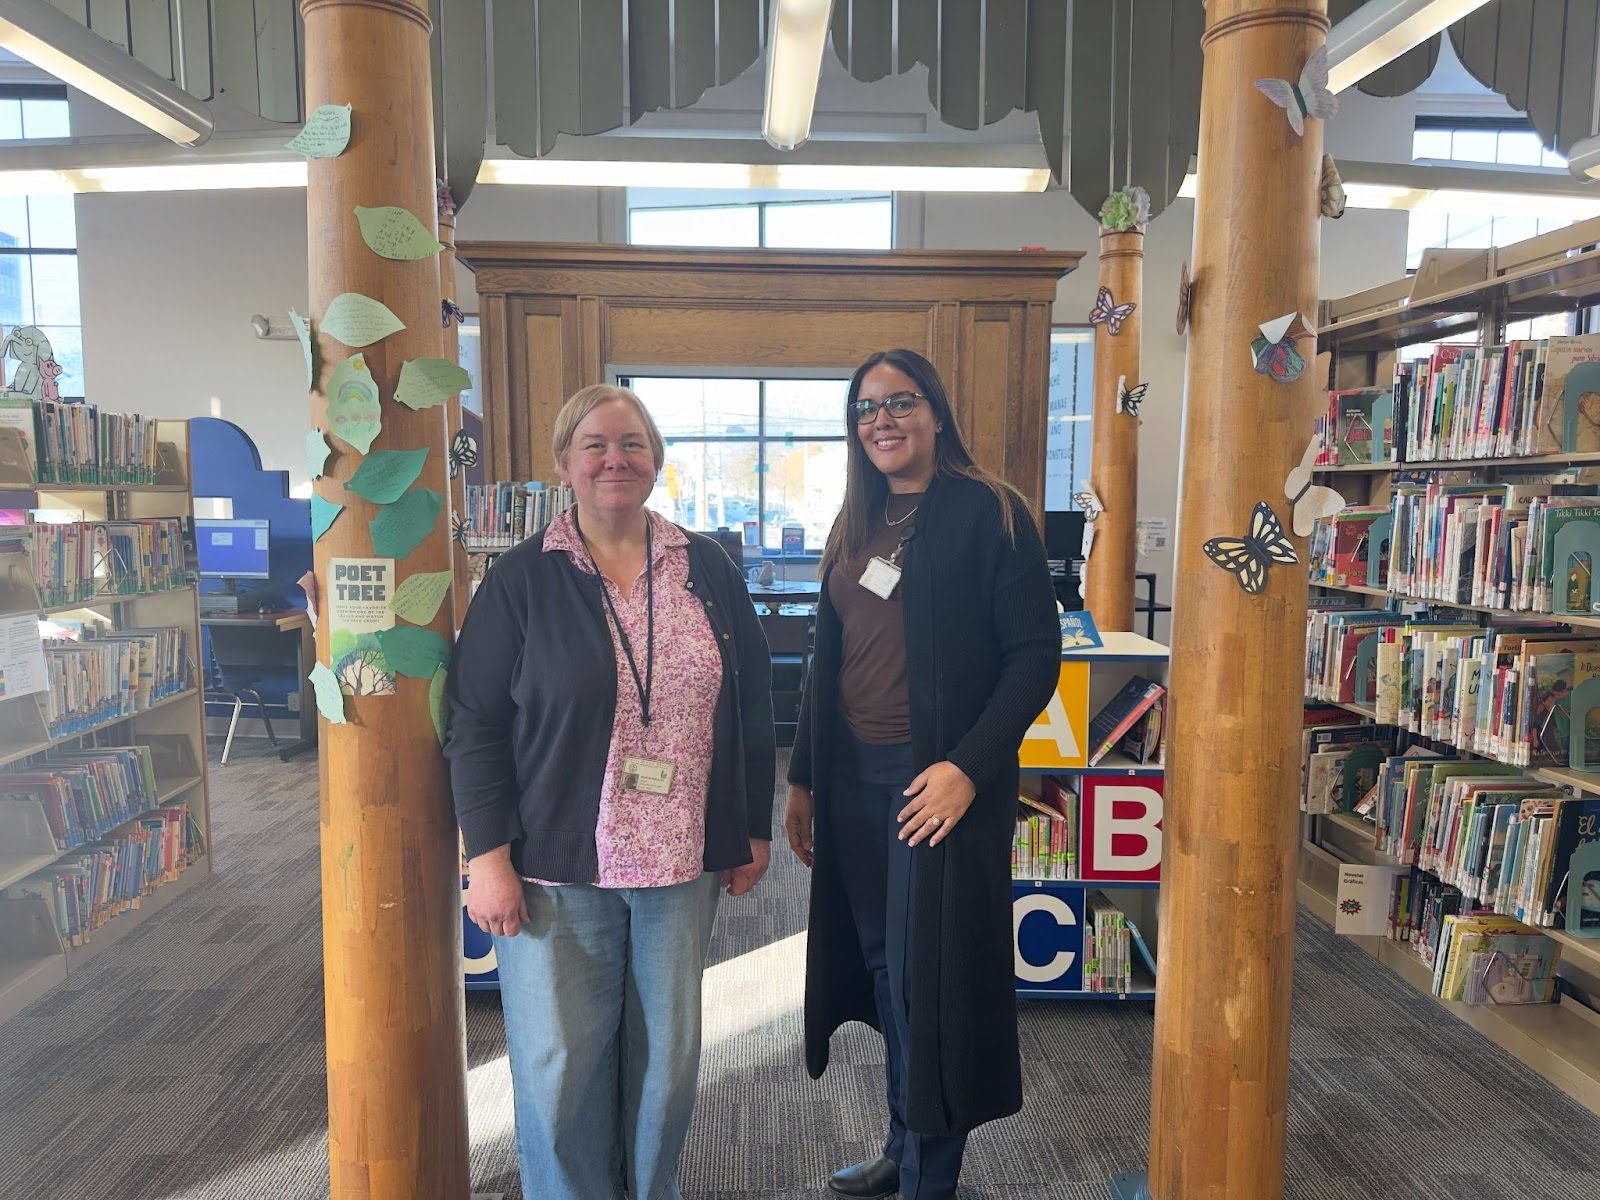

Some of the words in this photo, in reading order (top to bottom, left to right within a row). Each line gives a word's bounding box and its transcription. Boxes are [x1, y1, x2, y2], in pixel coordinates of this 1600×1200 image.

[1555, 509, 1572, 518] Tikki
[1574, 508, 1591, 517] Tikki
[335, 564, 387, 581] POET
[336, 584, 386, 601] TREE
[1024, 687, 1081, 758] A
[1093, 785, 1164, 871] B
[1578, 814, 1596, 835] El
[1013, 894, 1077, 983] C
